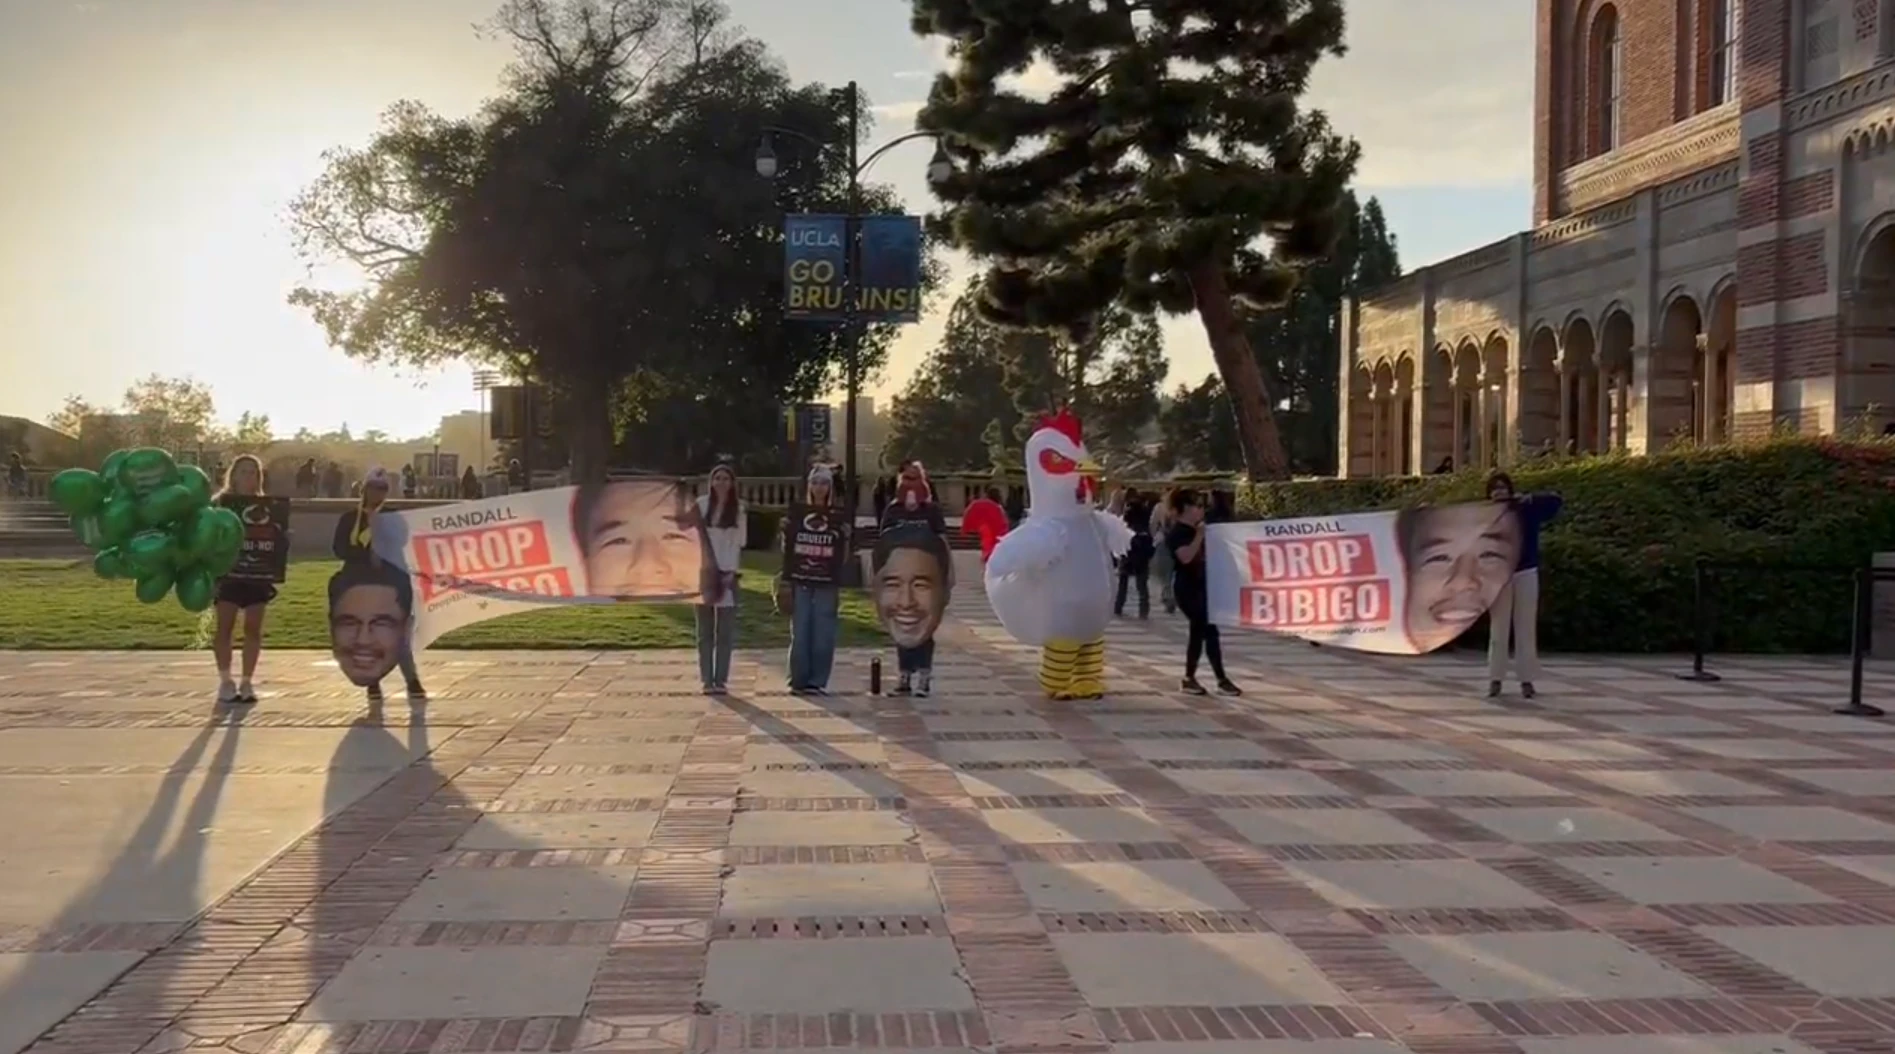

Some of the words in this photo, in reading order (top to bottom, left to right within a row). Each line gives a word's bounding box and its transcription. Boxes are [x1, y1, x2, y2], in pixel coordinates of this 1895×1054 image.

[791, 230, 840, 247] UCLA
[789, 259, 834, 283] GO
[432, 507, 517, 530] RANDALL
[1264, 521, 1346, 536] RANDALL
[427, 526, 534, 575] DROP
[1259, 539, 1362, 580] DROP
[1251, 584, 1380, 625] BIBIGO
